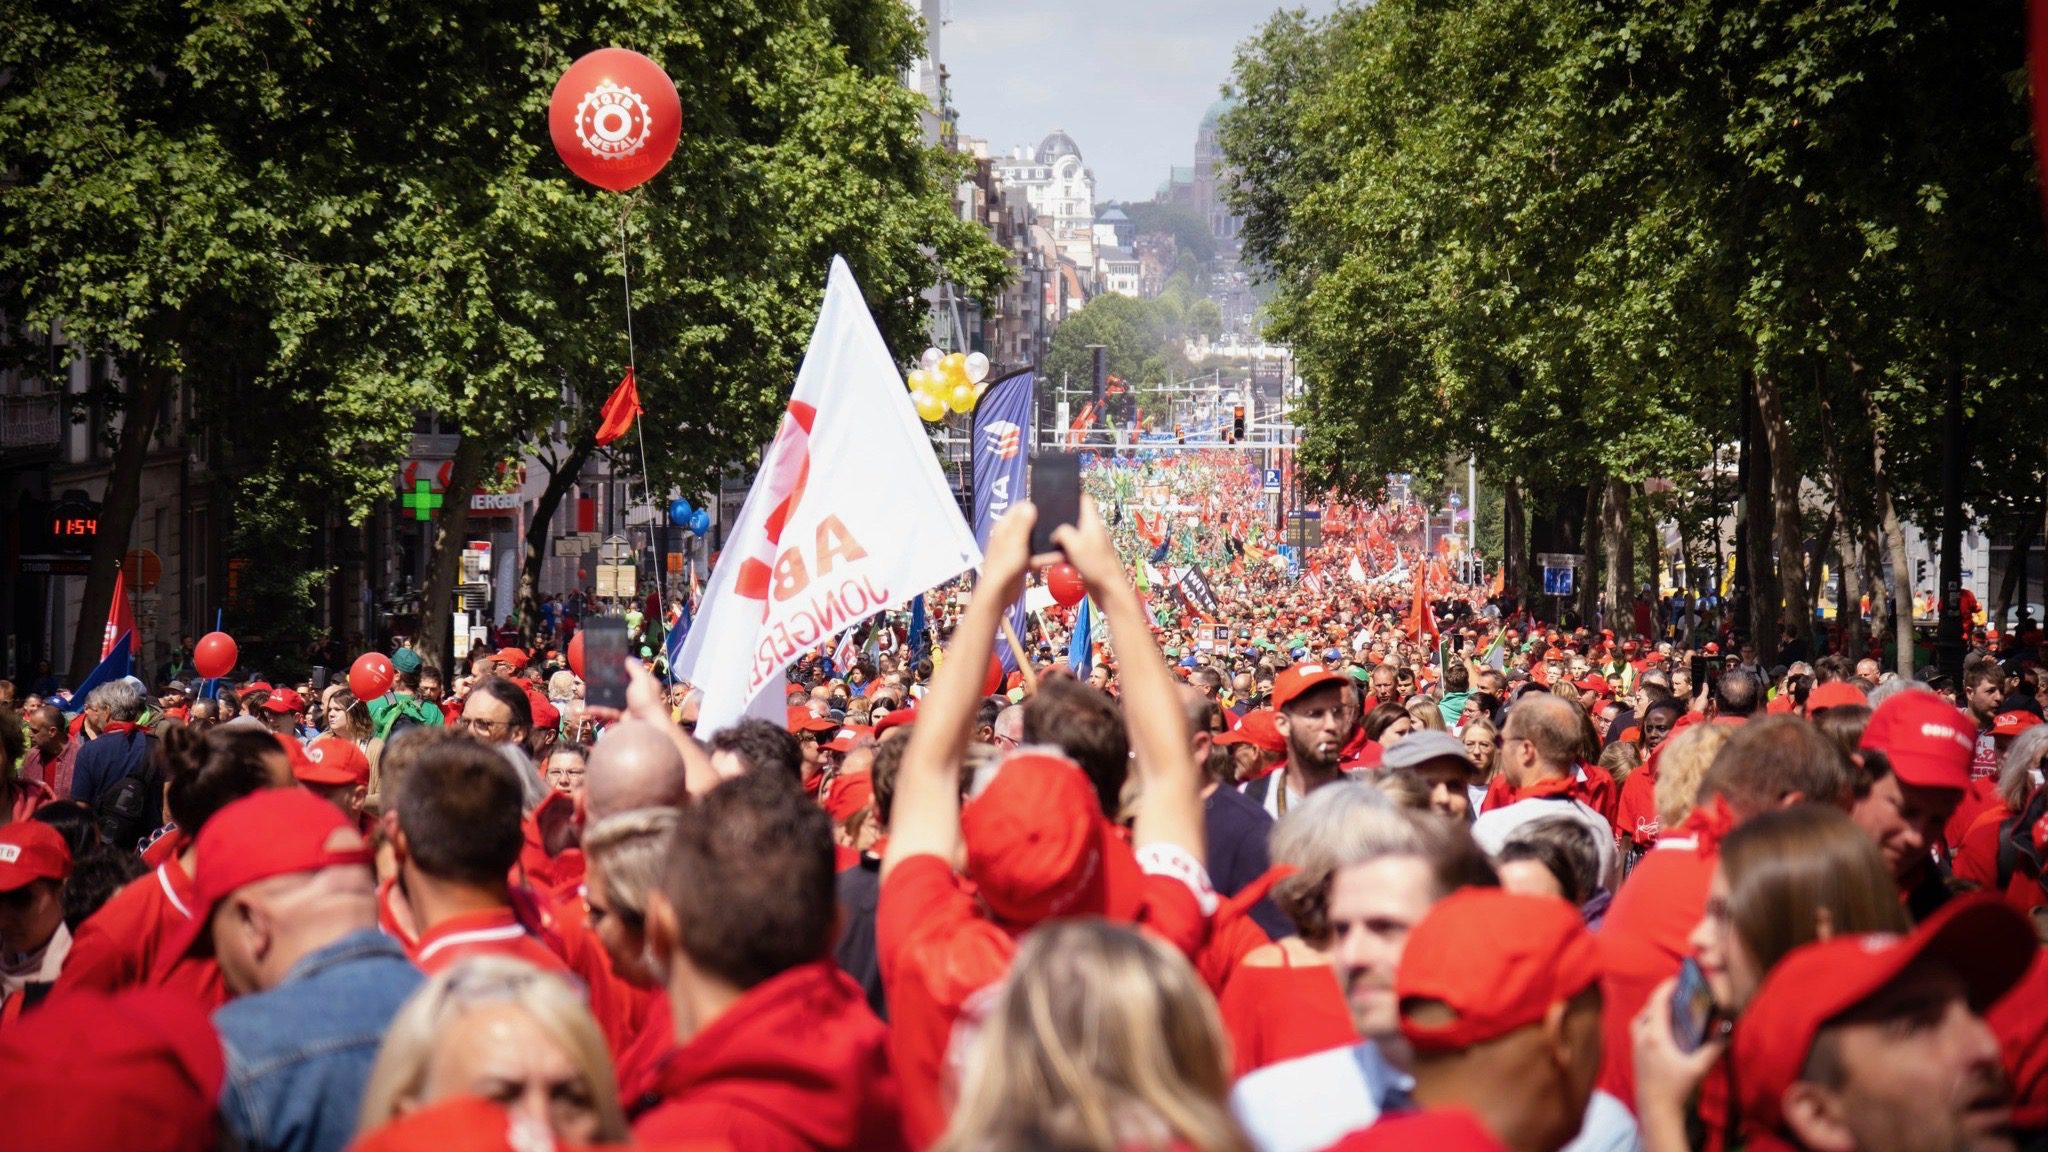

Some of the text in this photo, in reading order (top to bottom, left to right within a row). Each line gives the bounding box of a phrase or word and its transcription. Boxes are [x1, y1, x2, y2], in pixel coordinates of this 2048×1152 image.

[591, 93, 634, 110] FGTB
[589, 133, 637, 152] METAL
[54, 519, 97, 535] 11:54
